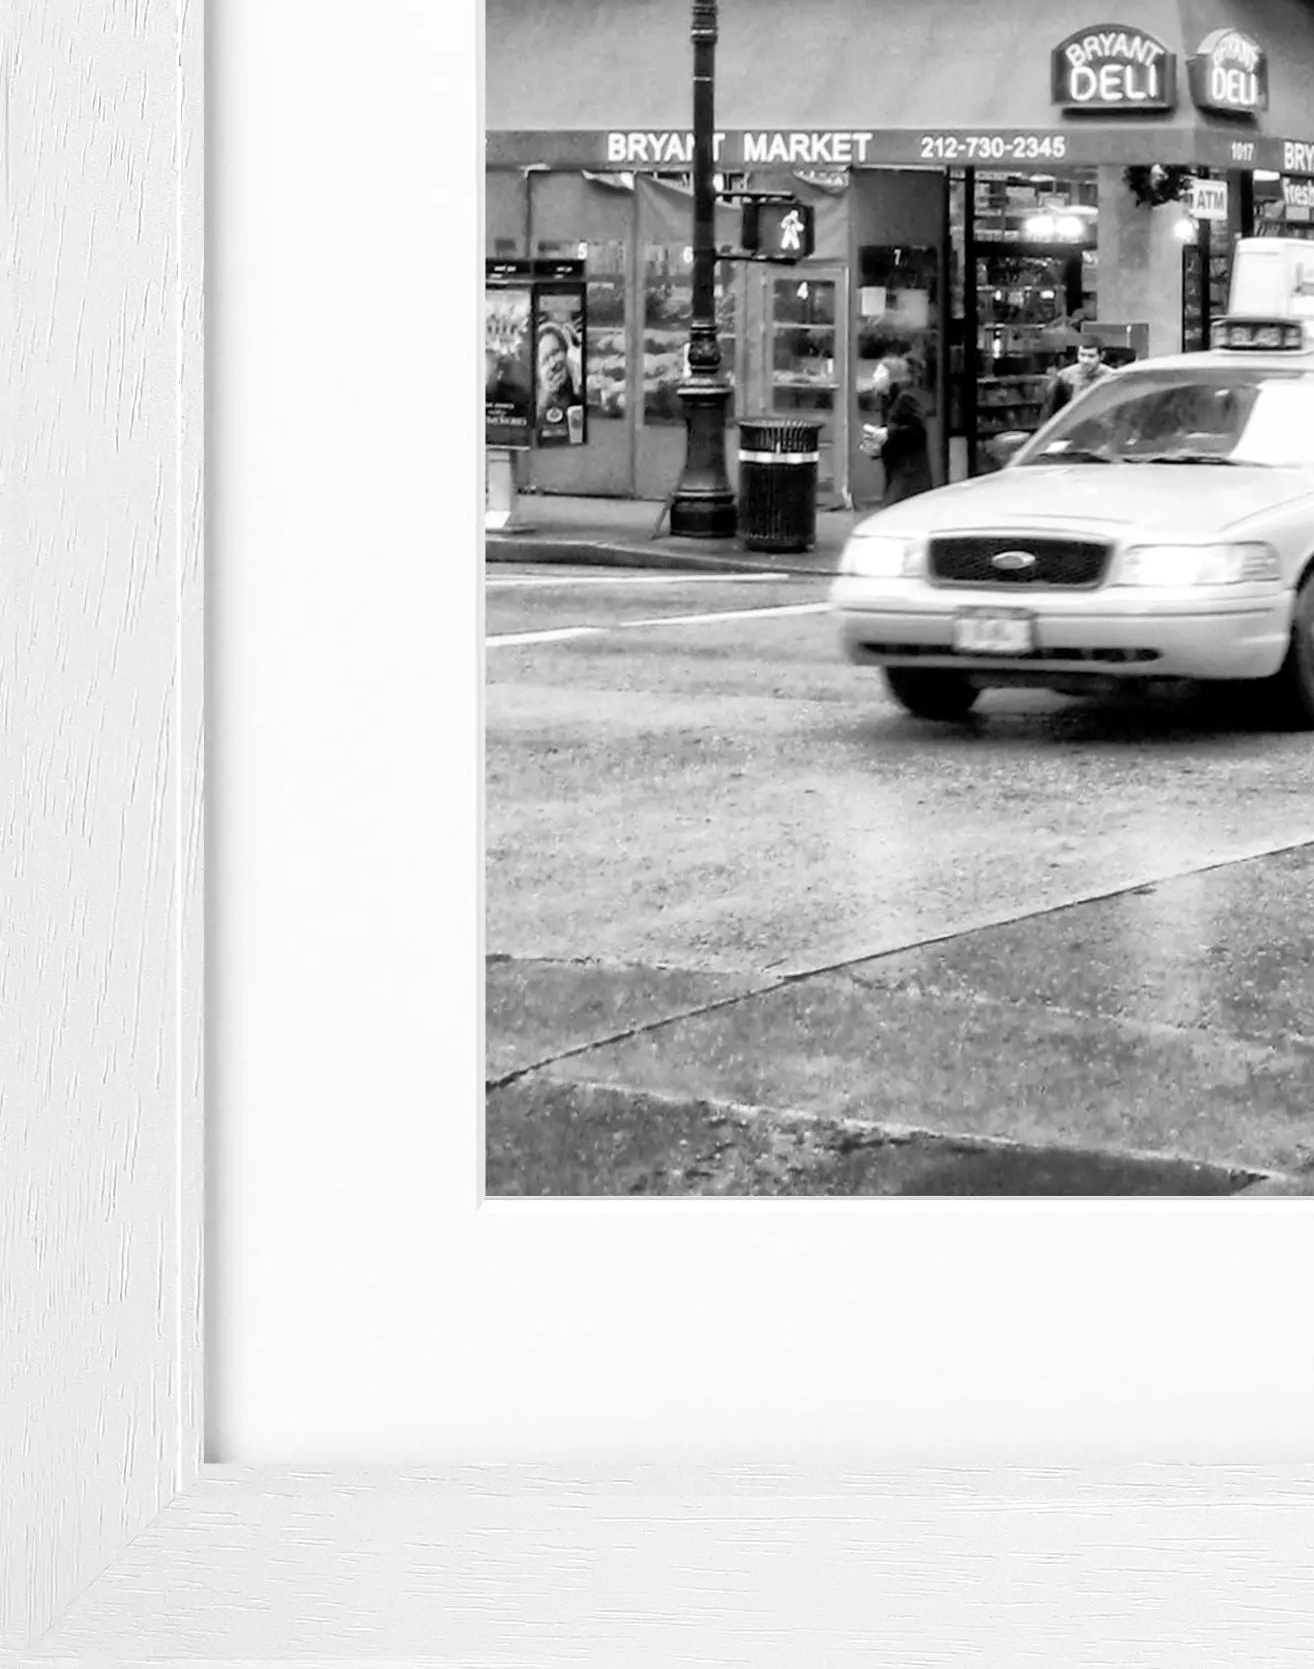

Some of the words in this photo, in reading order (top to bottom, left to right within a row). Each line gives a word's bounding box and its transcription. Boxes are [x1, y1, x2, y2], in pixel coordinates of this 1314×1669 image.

[1065, 32, 1165, 68] BRYANT
[1070, 64, 1157, 101] DELI
[1212, 66, 1257, 105] DELI
[743, 132, 873, 163] MARKET
[921, 135, 1066, 158] 212-730-2345
[1231, 142, 1254, 162] 1017
[1196, 190, 1225, 209] ATM
